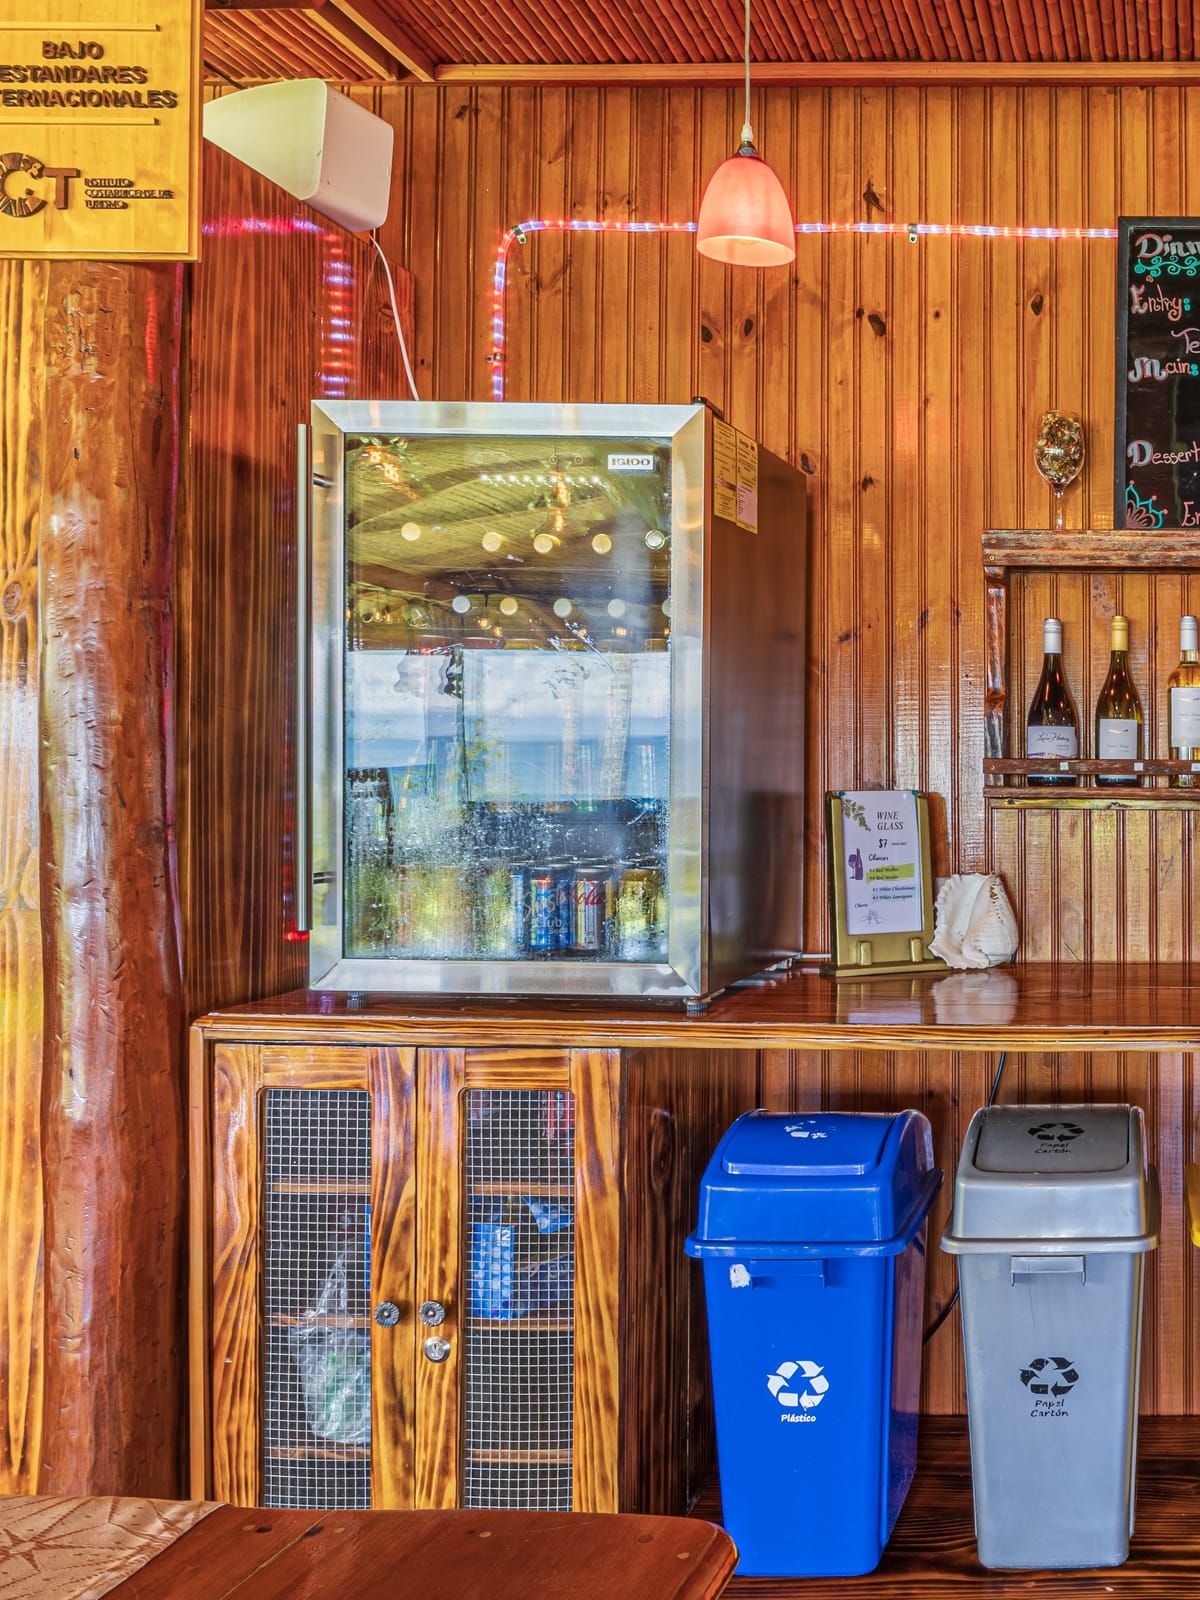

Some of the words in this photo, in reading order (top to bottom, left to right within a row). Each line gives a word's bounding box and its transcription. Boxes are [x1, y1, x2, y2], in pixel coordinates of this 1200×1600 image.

[41, 41, 105, 60] BAJO
[0, 65, 148, 85] ESTANDARES
[1129, 356, 1199, 382] Main:
[876, 811, 899, 820] WINE
[877, 821, 904, 831] GLASS
[878, 838, 888, 848] $7
[495, 1229, 511, 1241] 12
[780, 1413, 817, 1423] Plástico
